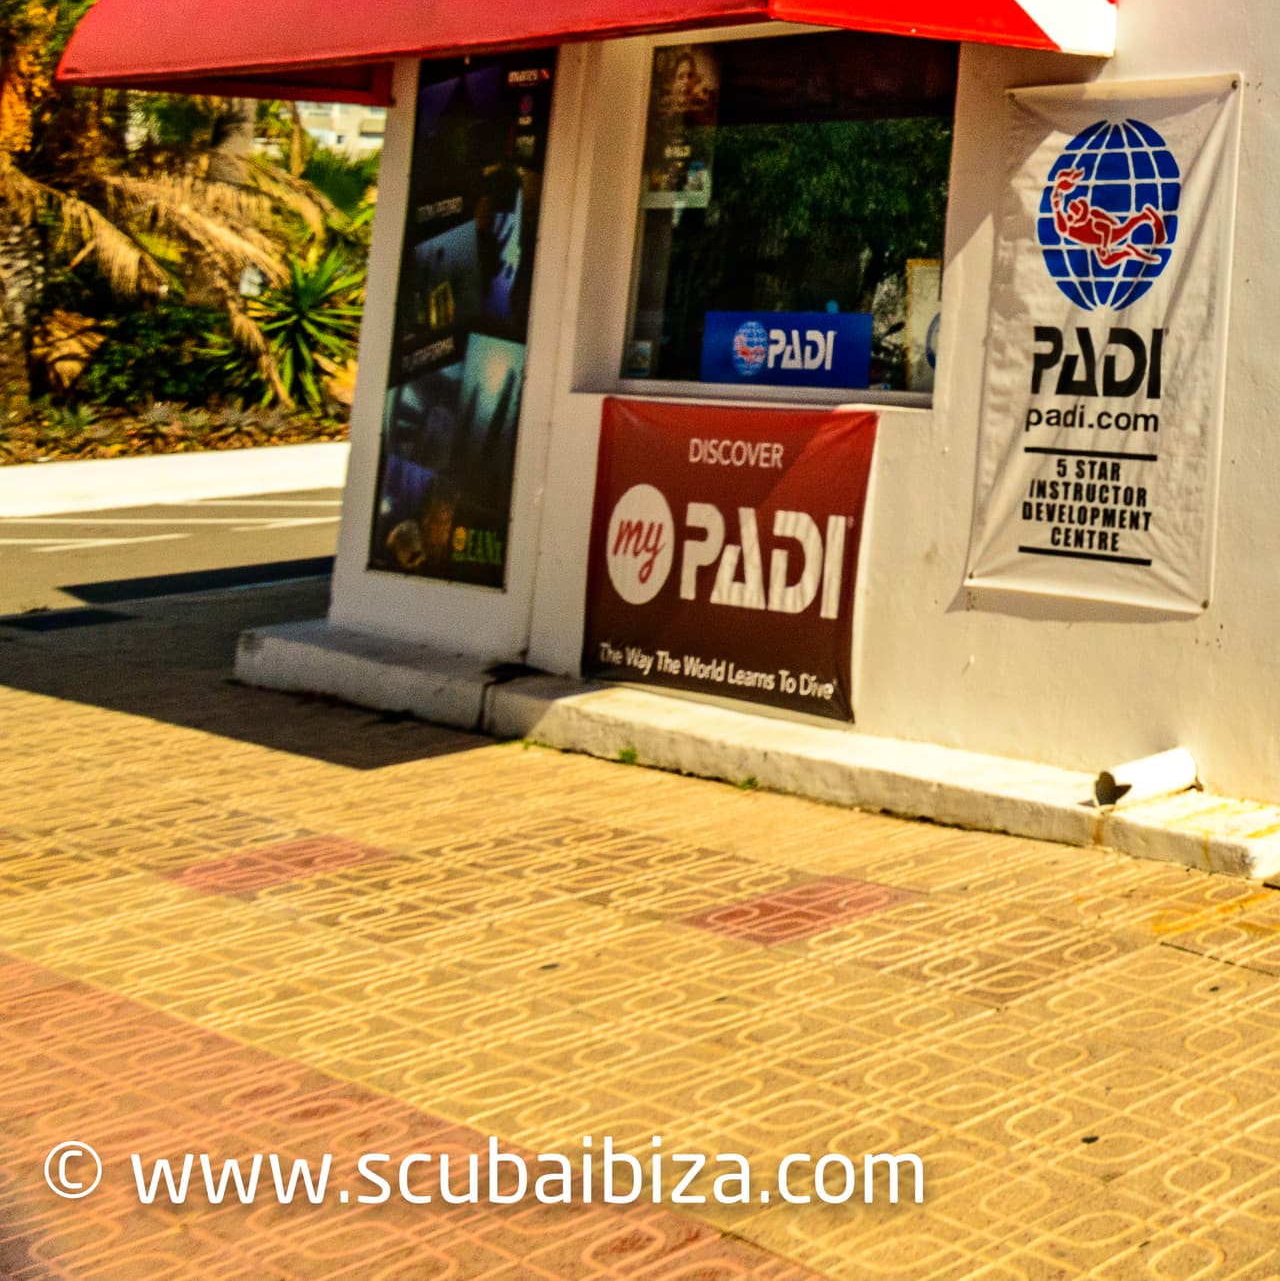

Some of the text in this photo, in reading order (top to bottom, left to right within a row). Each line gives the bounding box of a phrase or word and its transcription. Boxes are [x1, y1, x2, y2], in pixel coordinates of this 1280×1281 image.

[767, 329, 836, 371] PADI
[1031, 325, 1163, 399] PADI
[1025, 405, 1159, 432] padi.com
[689, 438, 784, 469] DISCOVER
[1057, 460, 1121, 481] 5 STAR
[1029, 479, 1147, 507] INSTRUCTOR
[1022, 502, 1153, 531] DEVELOPMENT
[613, 518, 665, 585] my
[1051, 526, 1120, 552] CENTRE
[679, 502, 847, 619] PADI
[600, 641, 835, 700] The Way The World Learns To Dive
